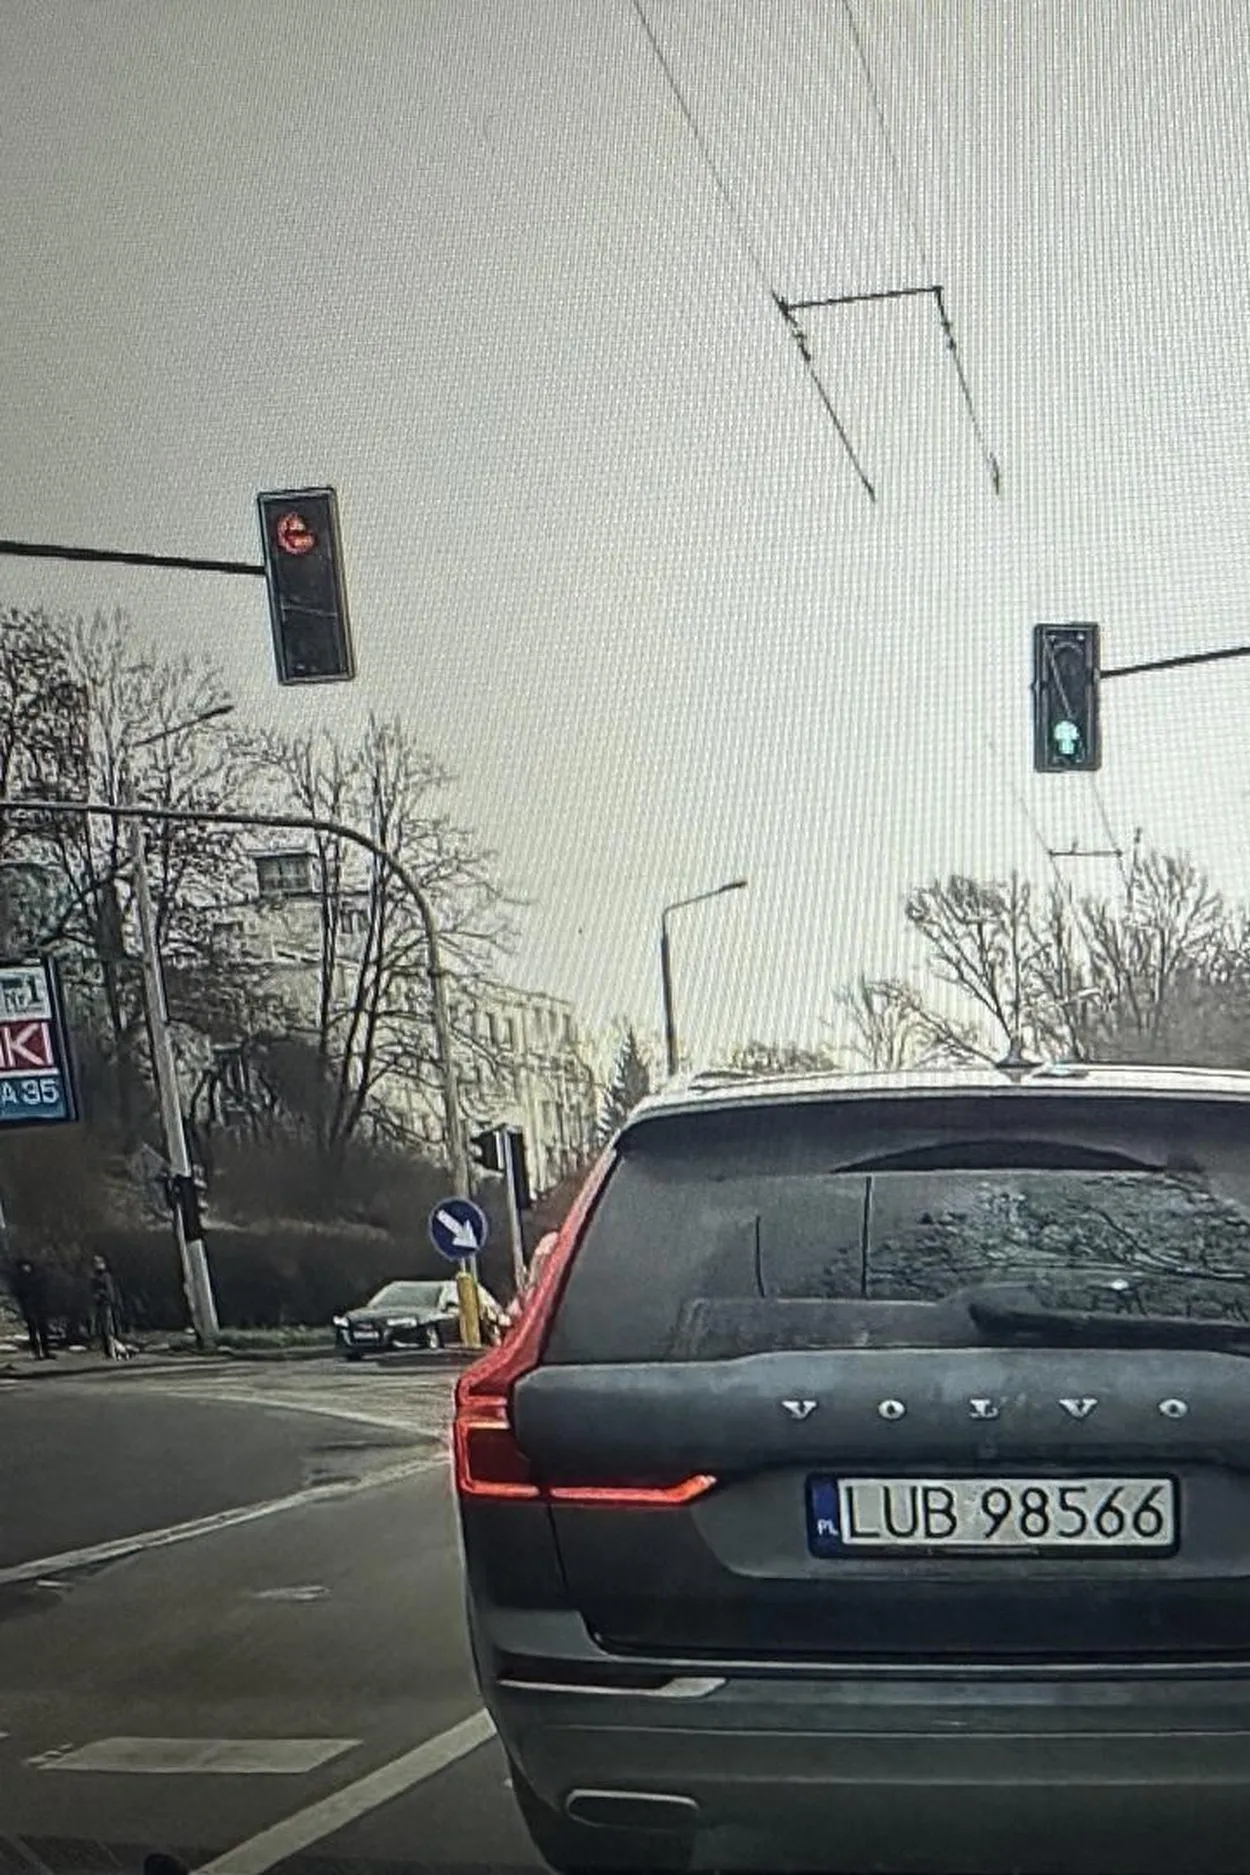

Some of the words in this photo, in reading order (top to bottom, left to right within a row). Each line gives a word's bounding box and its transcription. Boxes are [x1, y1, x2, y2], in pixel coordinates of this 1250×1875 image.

[782, 1399, 1189, 1421] VOLVO
[846, 1485, 958, 1539] LUB
[980, 1484, 1166, 1539] 98566
[817, 1518, 839, 1536] PL
